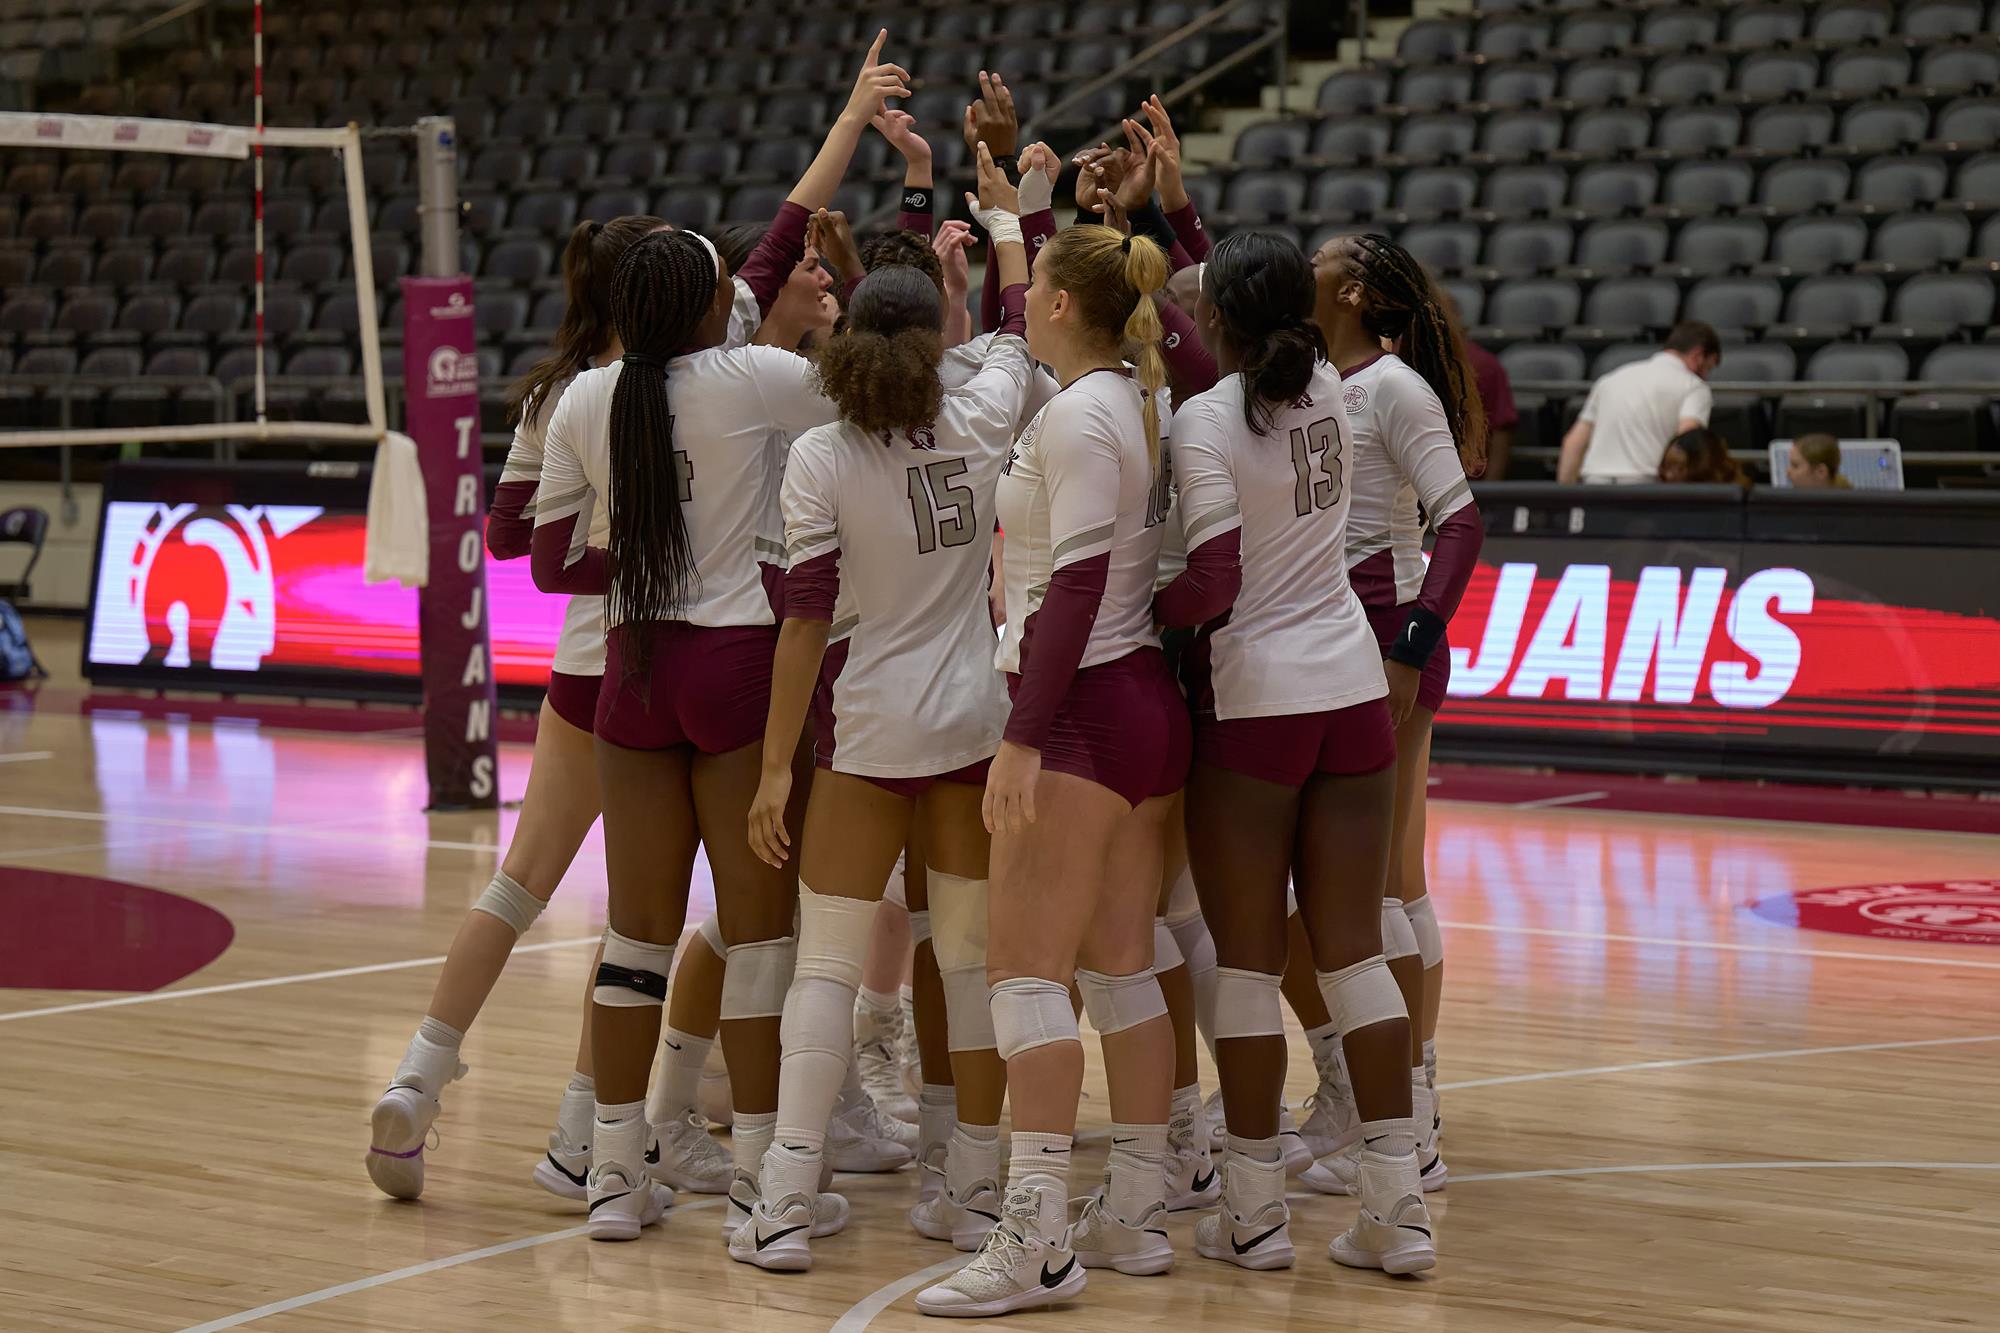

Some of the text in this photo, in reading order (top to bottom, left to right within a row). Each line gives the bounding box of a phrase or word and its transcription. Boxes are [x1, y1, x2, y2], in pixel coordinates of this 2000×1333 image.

[907, 458, 976, 554] 15
[1290, 417, 1342, 517] 13
[455, 418, 492, 797] TROJANS
[1446, 562, 1814, 708] JANS
